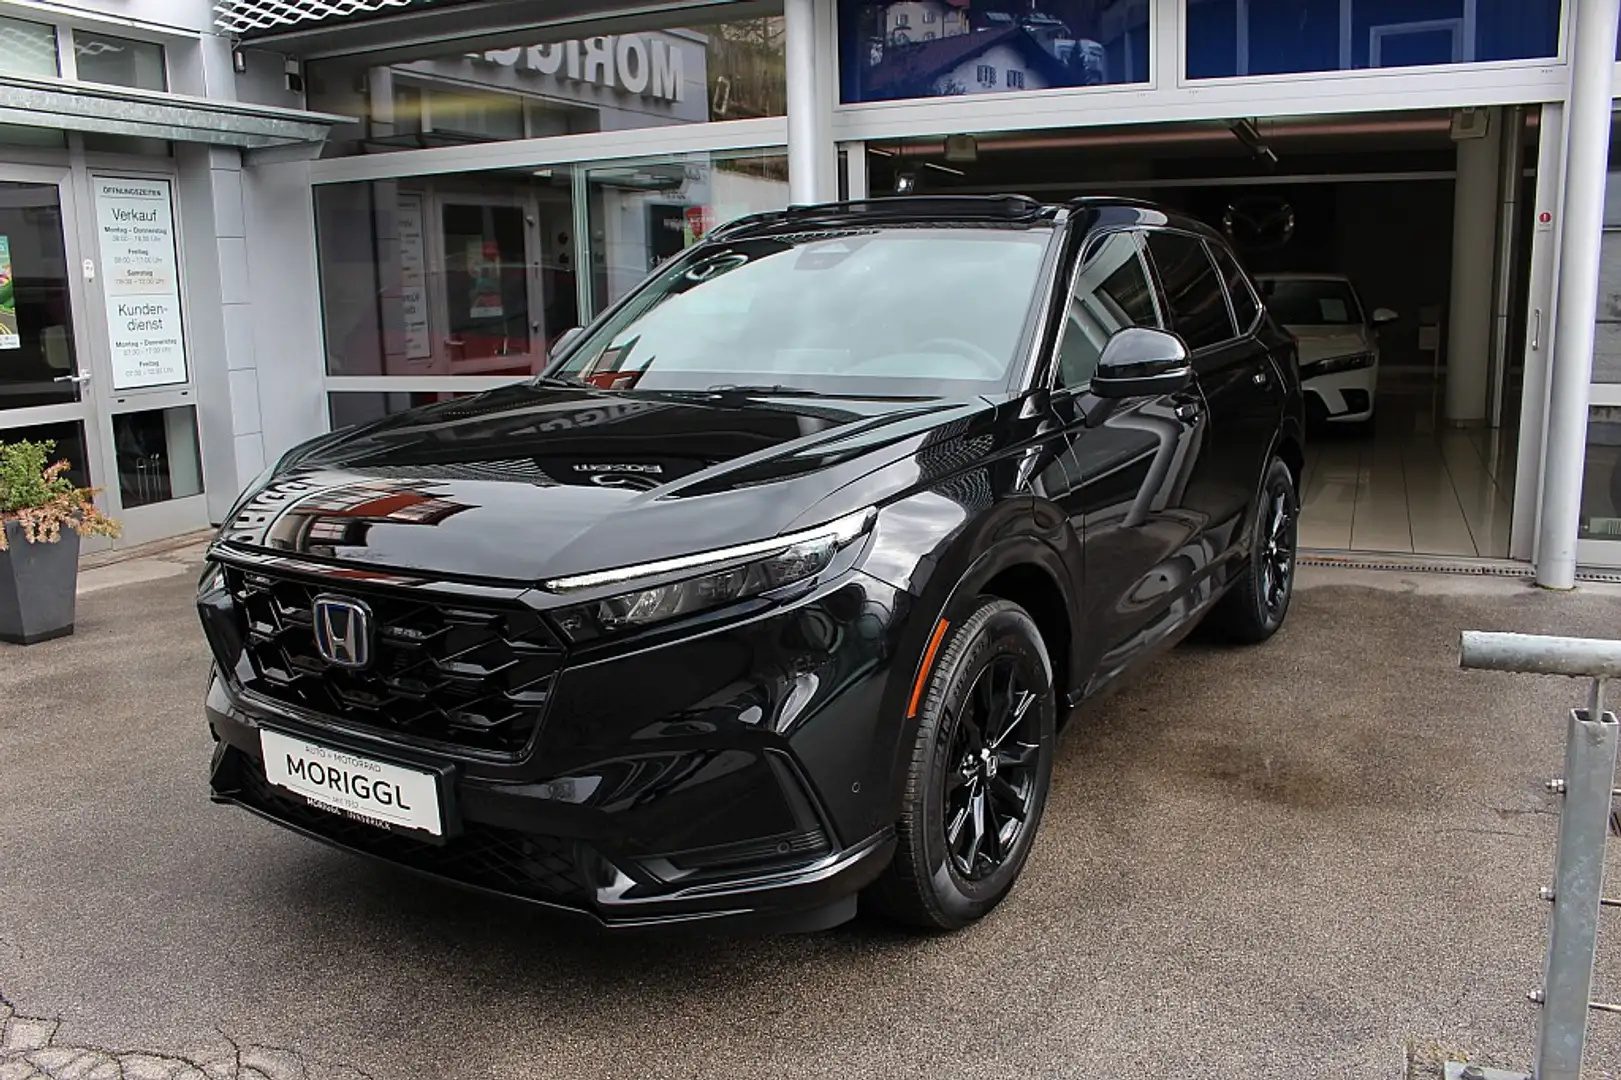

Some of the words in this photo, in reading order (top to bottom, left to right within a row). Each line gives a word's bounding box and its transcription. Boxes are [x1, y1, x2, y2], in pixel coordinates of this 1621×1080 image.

[112, 208, 157, 222] Verkauf
[134, 227, 167, 235] Donnerstag
[128, 248, 148, 256] Freitag
[127, 269, 153, 277] Samstag
[118, 304, 168, 316] Kunden-
[127, 319, 163, 331] dienst
[116, 340, 139, 348] Montag
[144, 338, 177, 346] Donnerstag
[139, 360, 160, 368] Freitag
[305, 745, 326, 758] AUTO
[334, 753, 381, 773] MOTORRAD
[286, 754, 411, 810] MORIGGL
